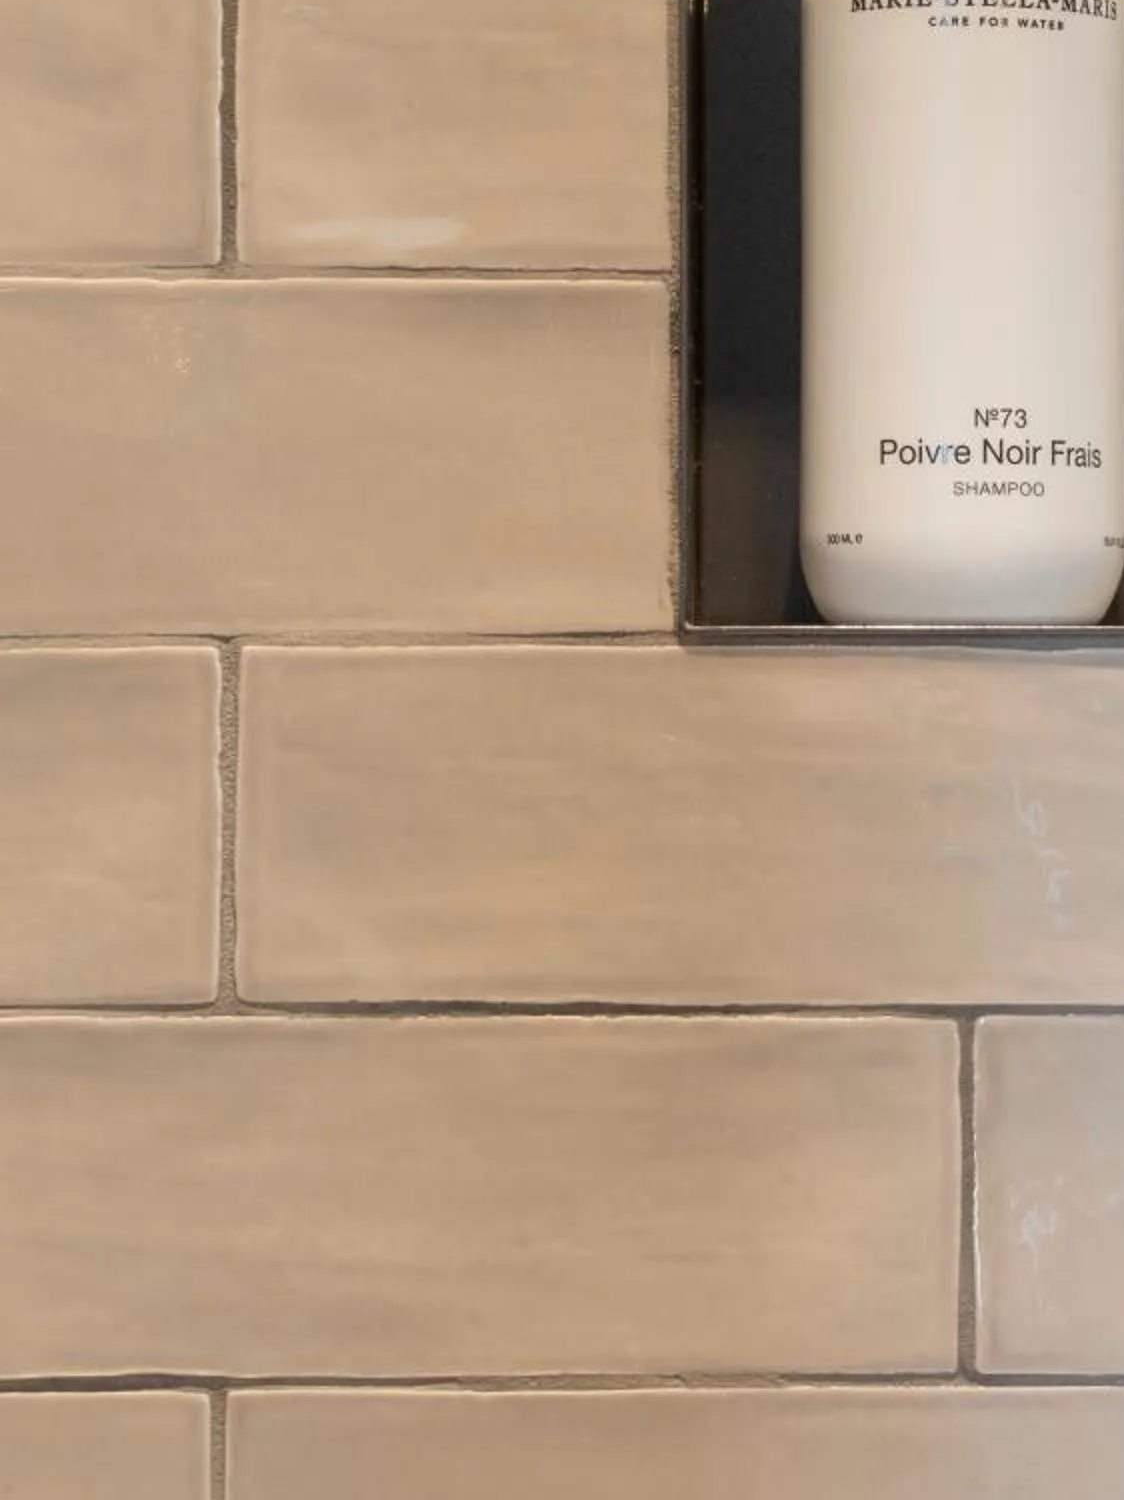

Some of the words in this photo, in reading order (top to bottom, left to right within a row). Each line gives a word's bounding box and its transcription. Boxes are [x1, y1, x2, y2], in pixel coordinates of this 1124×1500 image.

[928, 15, 970, 27] CARE
[979, 15, 1009, 28] FOR
[1017, 17, 1065, 31] WATER
[880, 438, 972, 466] Poivre
[983, 438, 1042, 465] Noir
[1051, 440, 1102, 468] Frais
[952, 481, 1045, 497] SHAMPOO
